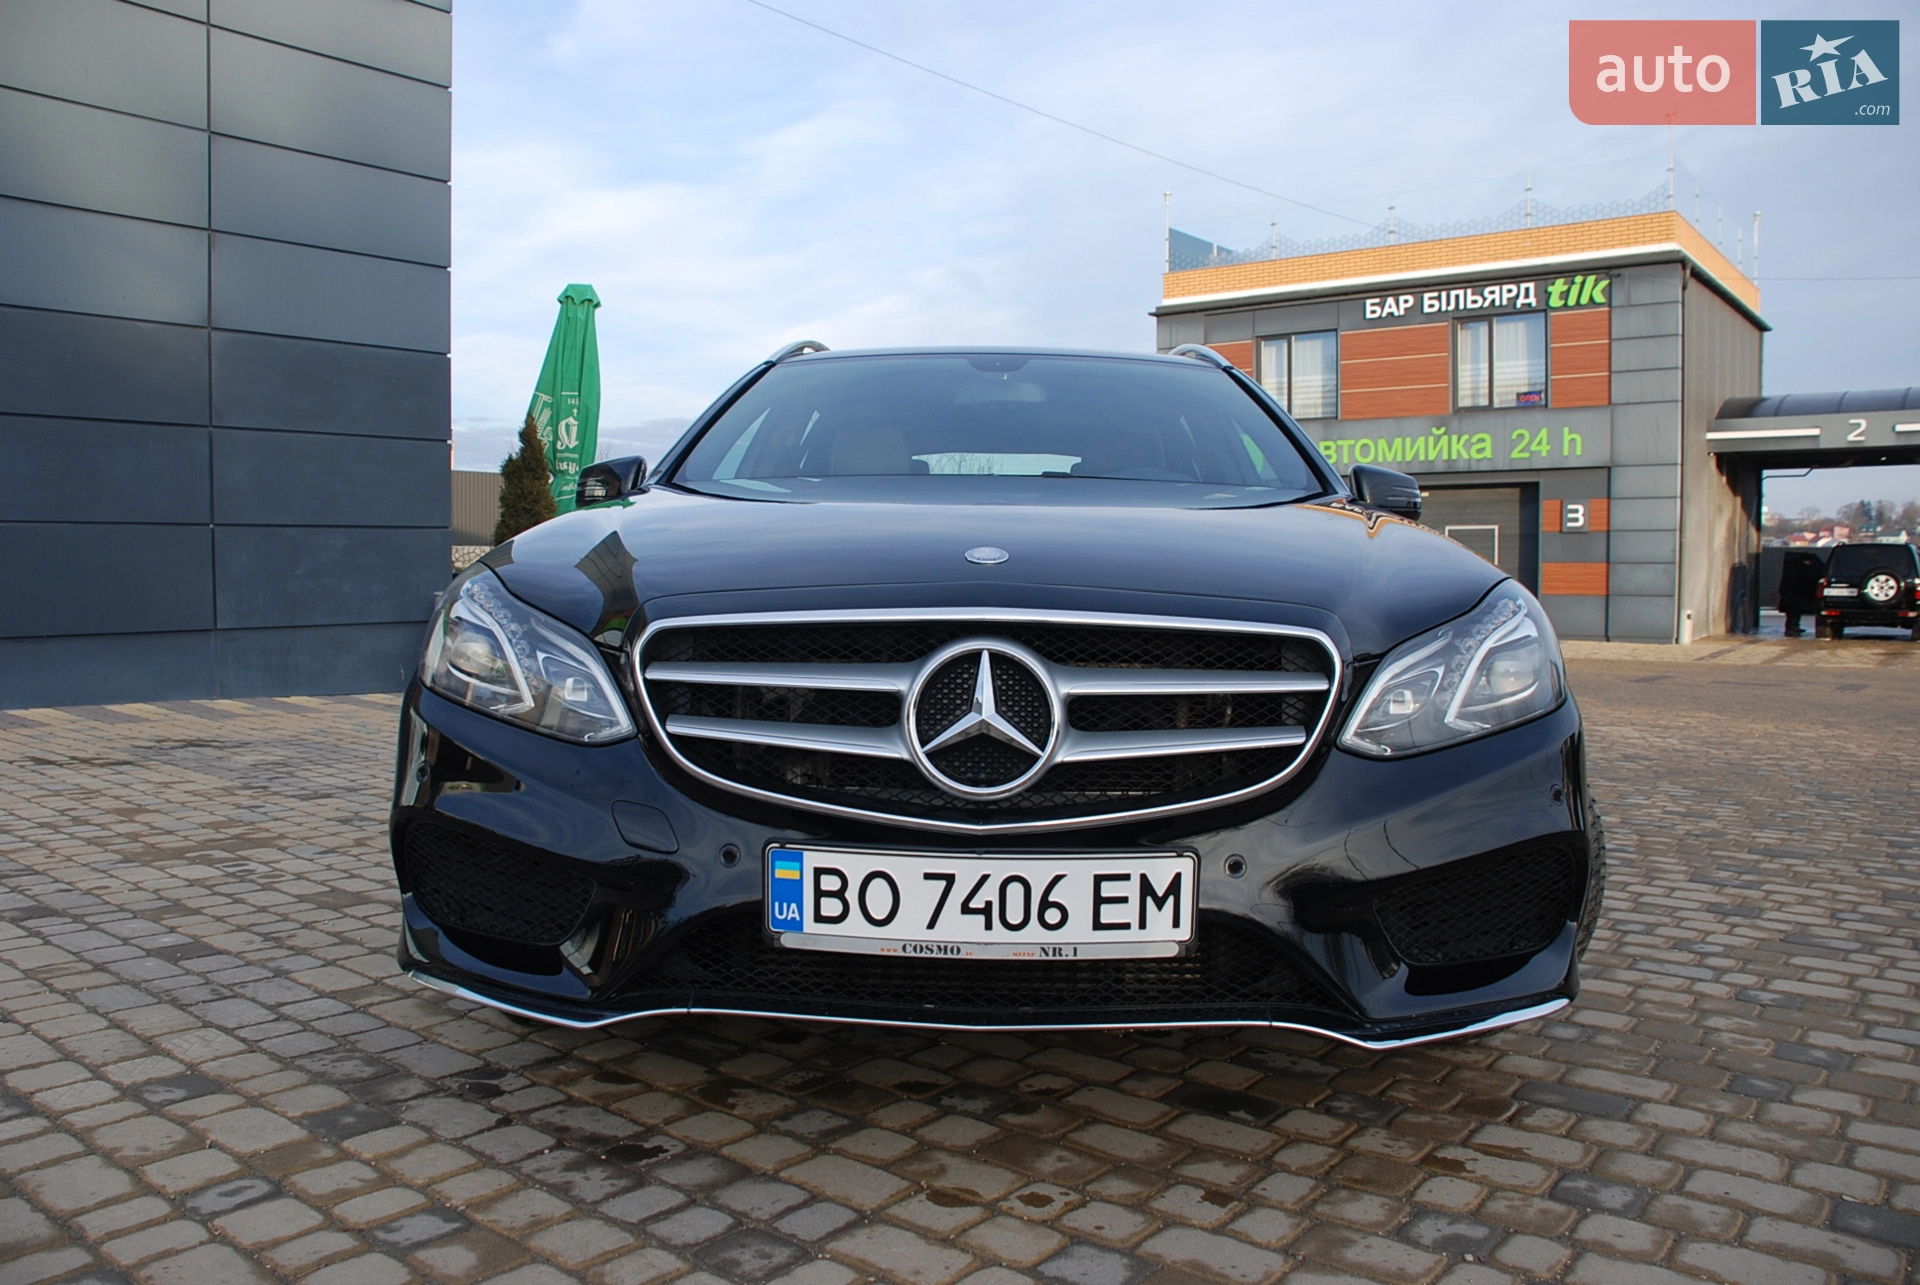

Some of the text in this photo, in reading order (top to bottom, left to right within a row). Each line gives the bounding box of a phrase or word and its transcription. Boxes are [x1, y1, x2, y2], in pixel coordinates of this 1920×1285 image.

[1365, 275, 1610, 319] БАР БІЛЬЯРД tik
[1318, 427, 1583, 464] втомийка 24 h
[1846, 418, 1868, 442] 2
[1566, 504, 1585, 528] 3
[774, 866, 1182, 932] UA BO 7406 EM
